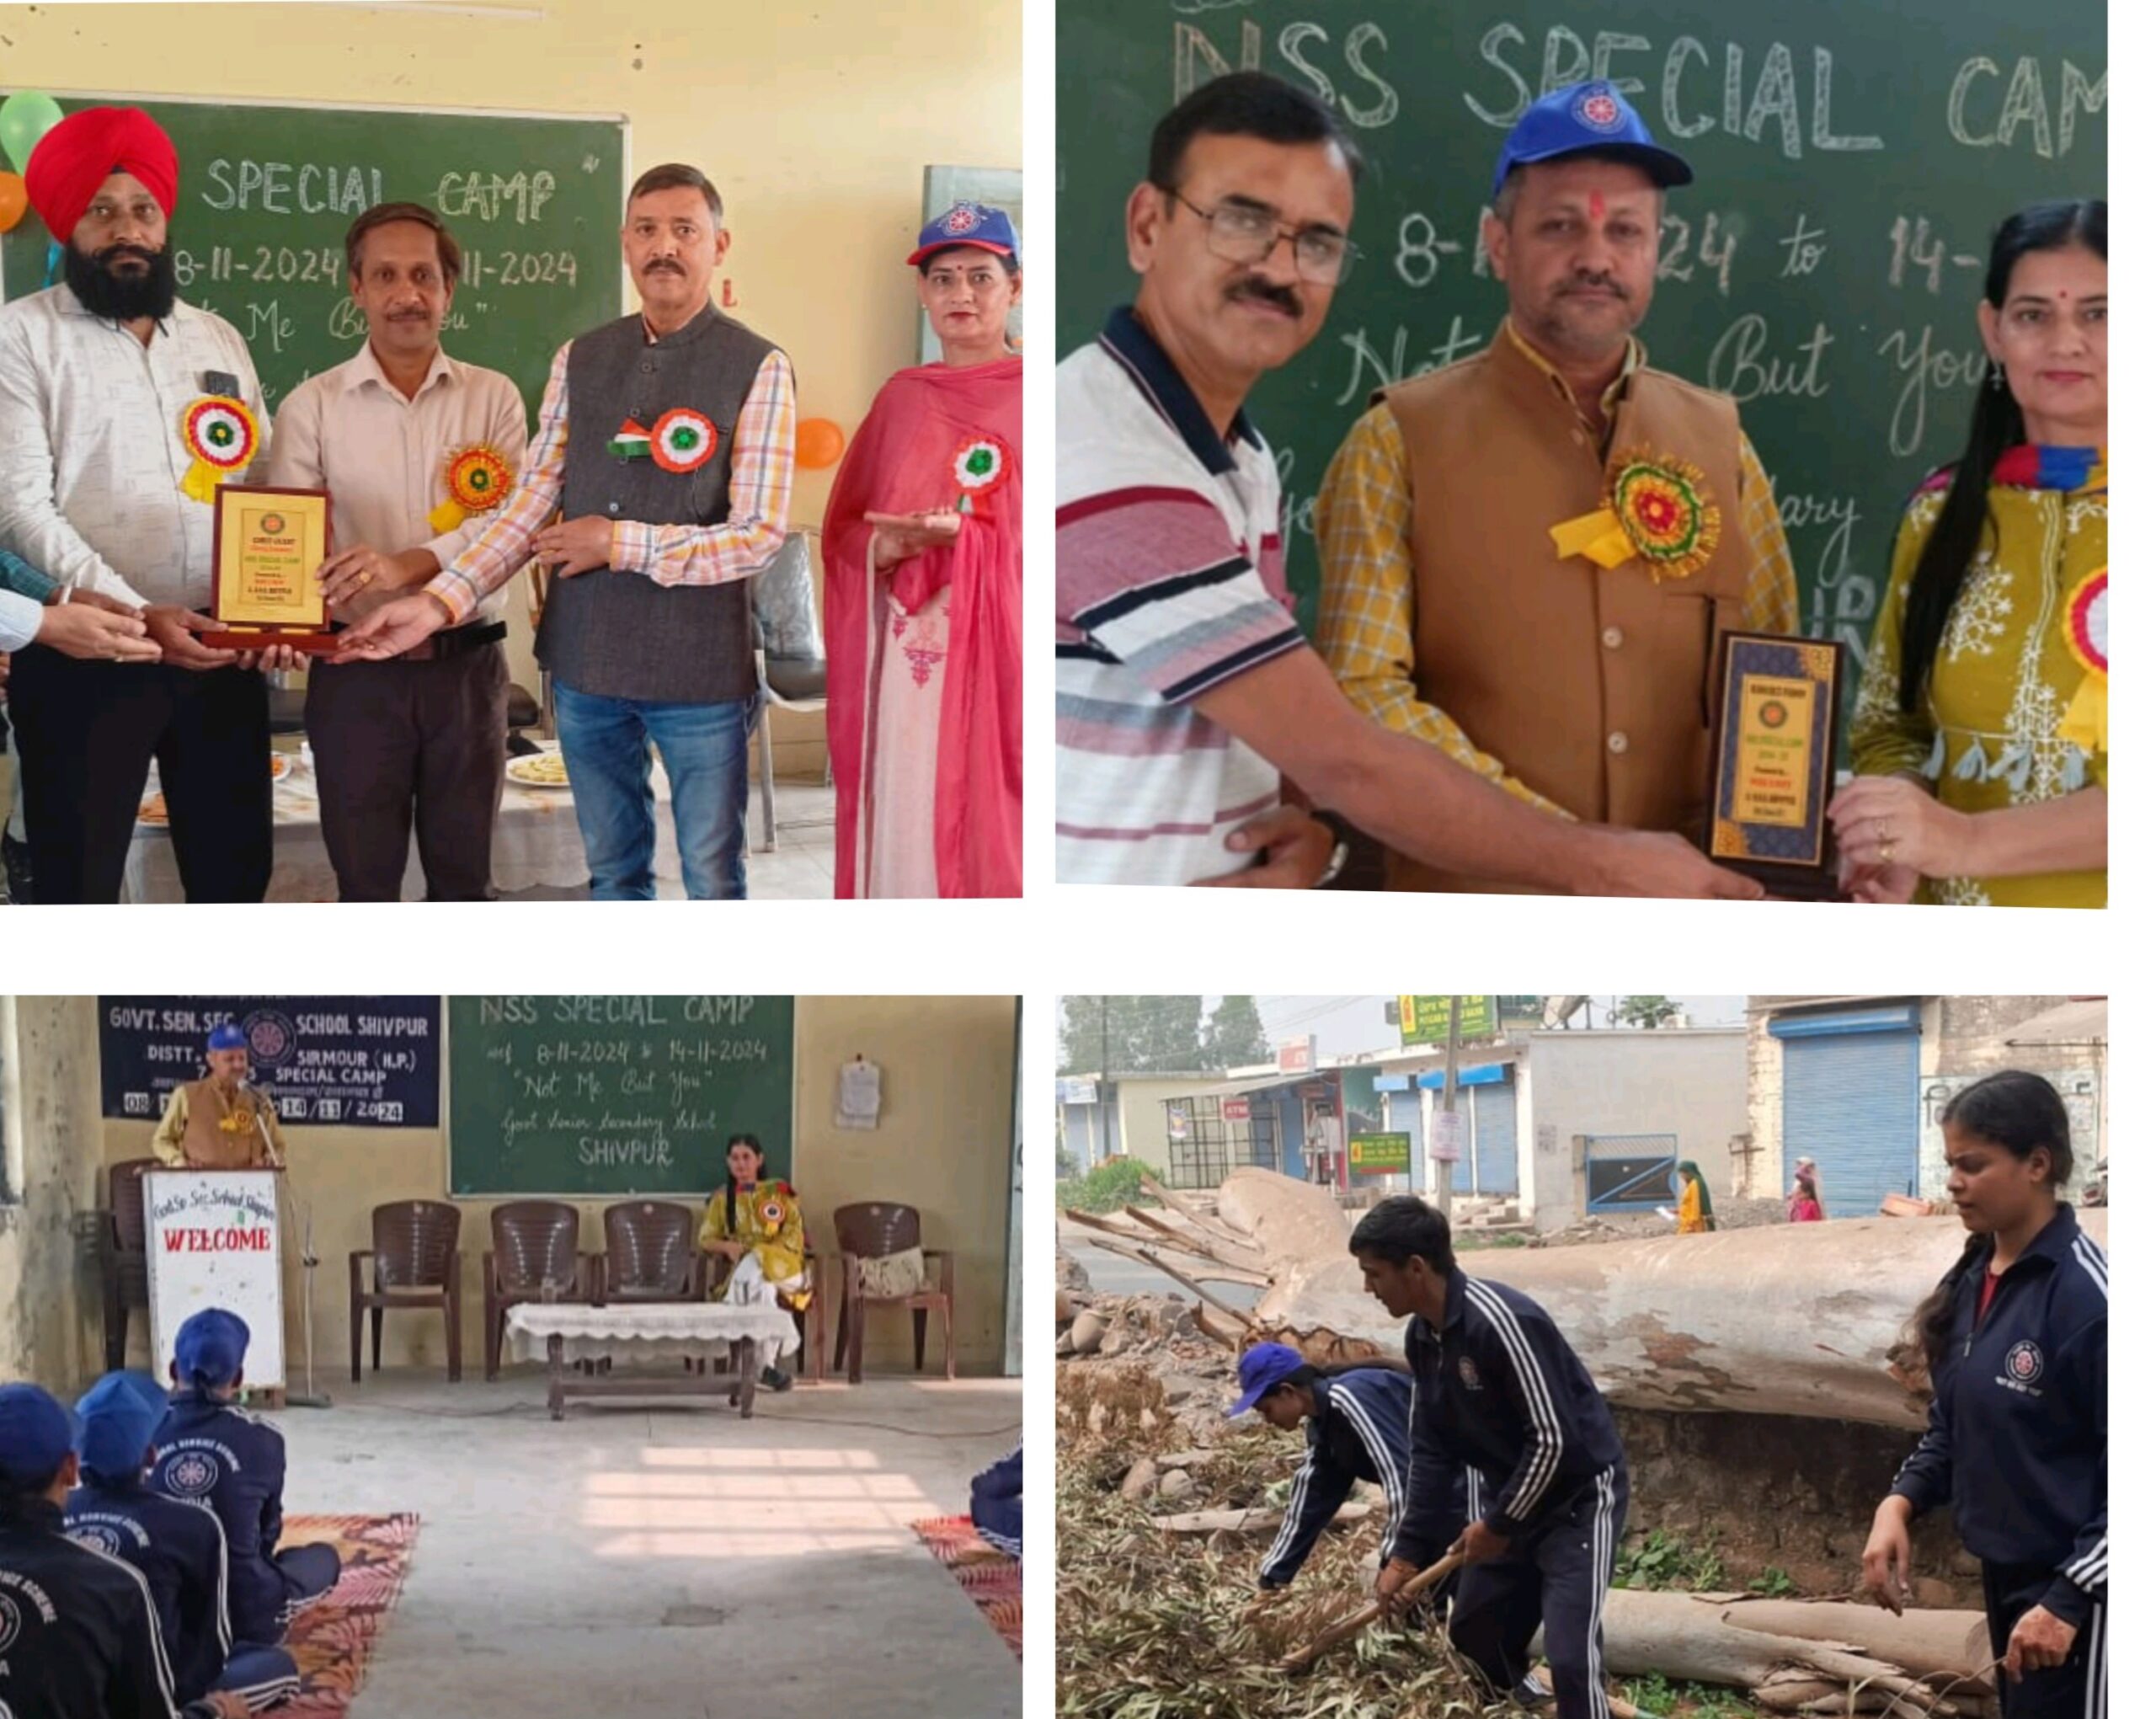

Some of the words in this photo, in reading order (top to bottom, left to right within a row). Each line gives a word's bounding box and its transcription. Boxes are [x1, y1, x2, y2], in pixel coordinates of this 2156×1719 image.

[1464, 23, 1884, 159] SPECIAL
[1947, 56, 2108, 159] CAM
[202, 158, 382, 214] SPECIAL
[435, 168, 556, 224] CAMP
[1779, 214, 1828, 278] to
[174, 248, 339, 286] 8-11-2024
[462, 251, 578, 288] 11-2024
[246, 299, 296, 353] Me
[328, 295, 369, 338] Bu
[1708, 314, 1834, 403] But
[1879, 324, 1986, 456] You
[109, 1006, 160, 1032] GOVT.
[296, 1014, 352, 1035] SCHOOL
[358, 1016, 428, 1037] SHIVPUR
[480, 996, 538, 1025] NSS
[553, 996, 668, 1027] SPECIAL
[684, 996, 755, 1026] CAMP
[147, 1045, 202, 1063] DISTT.
[297, 1050, 368, 1066] SIRMOUR
[536, 1039, 631, 1065] 8-11-2024
[670, 1037, 767, 1064] 14-11-2024
[275, 1067, 336, 1083] SPECIAL
[340, 1068, 387, 1085] CAMP
[579, 1136, 675, 1169] SHIVPUR
[163, 1227, 271, 1252] WELCOME
